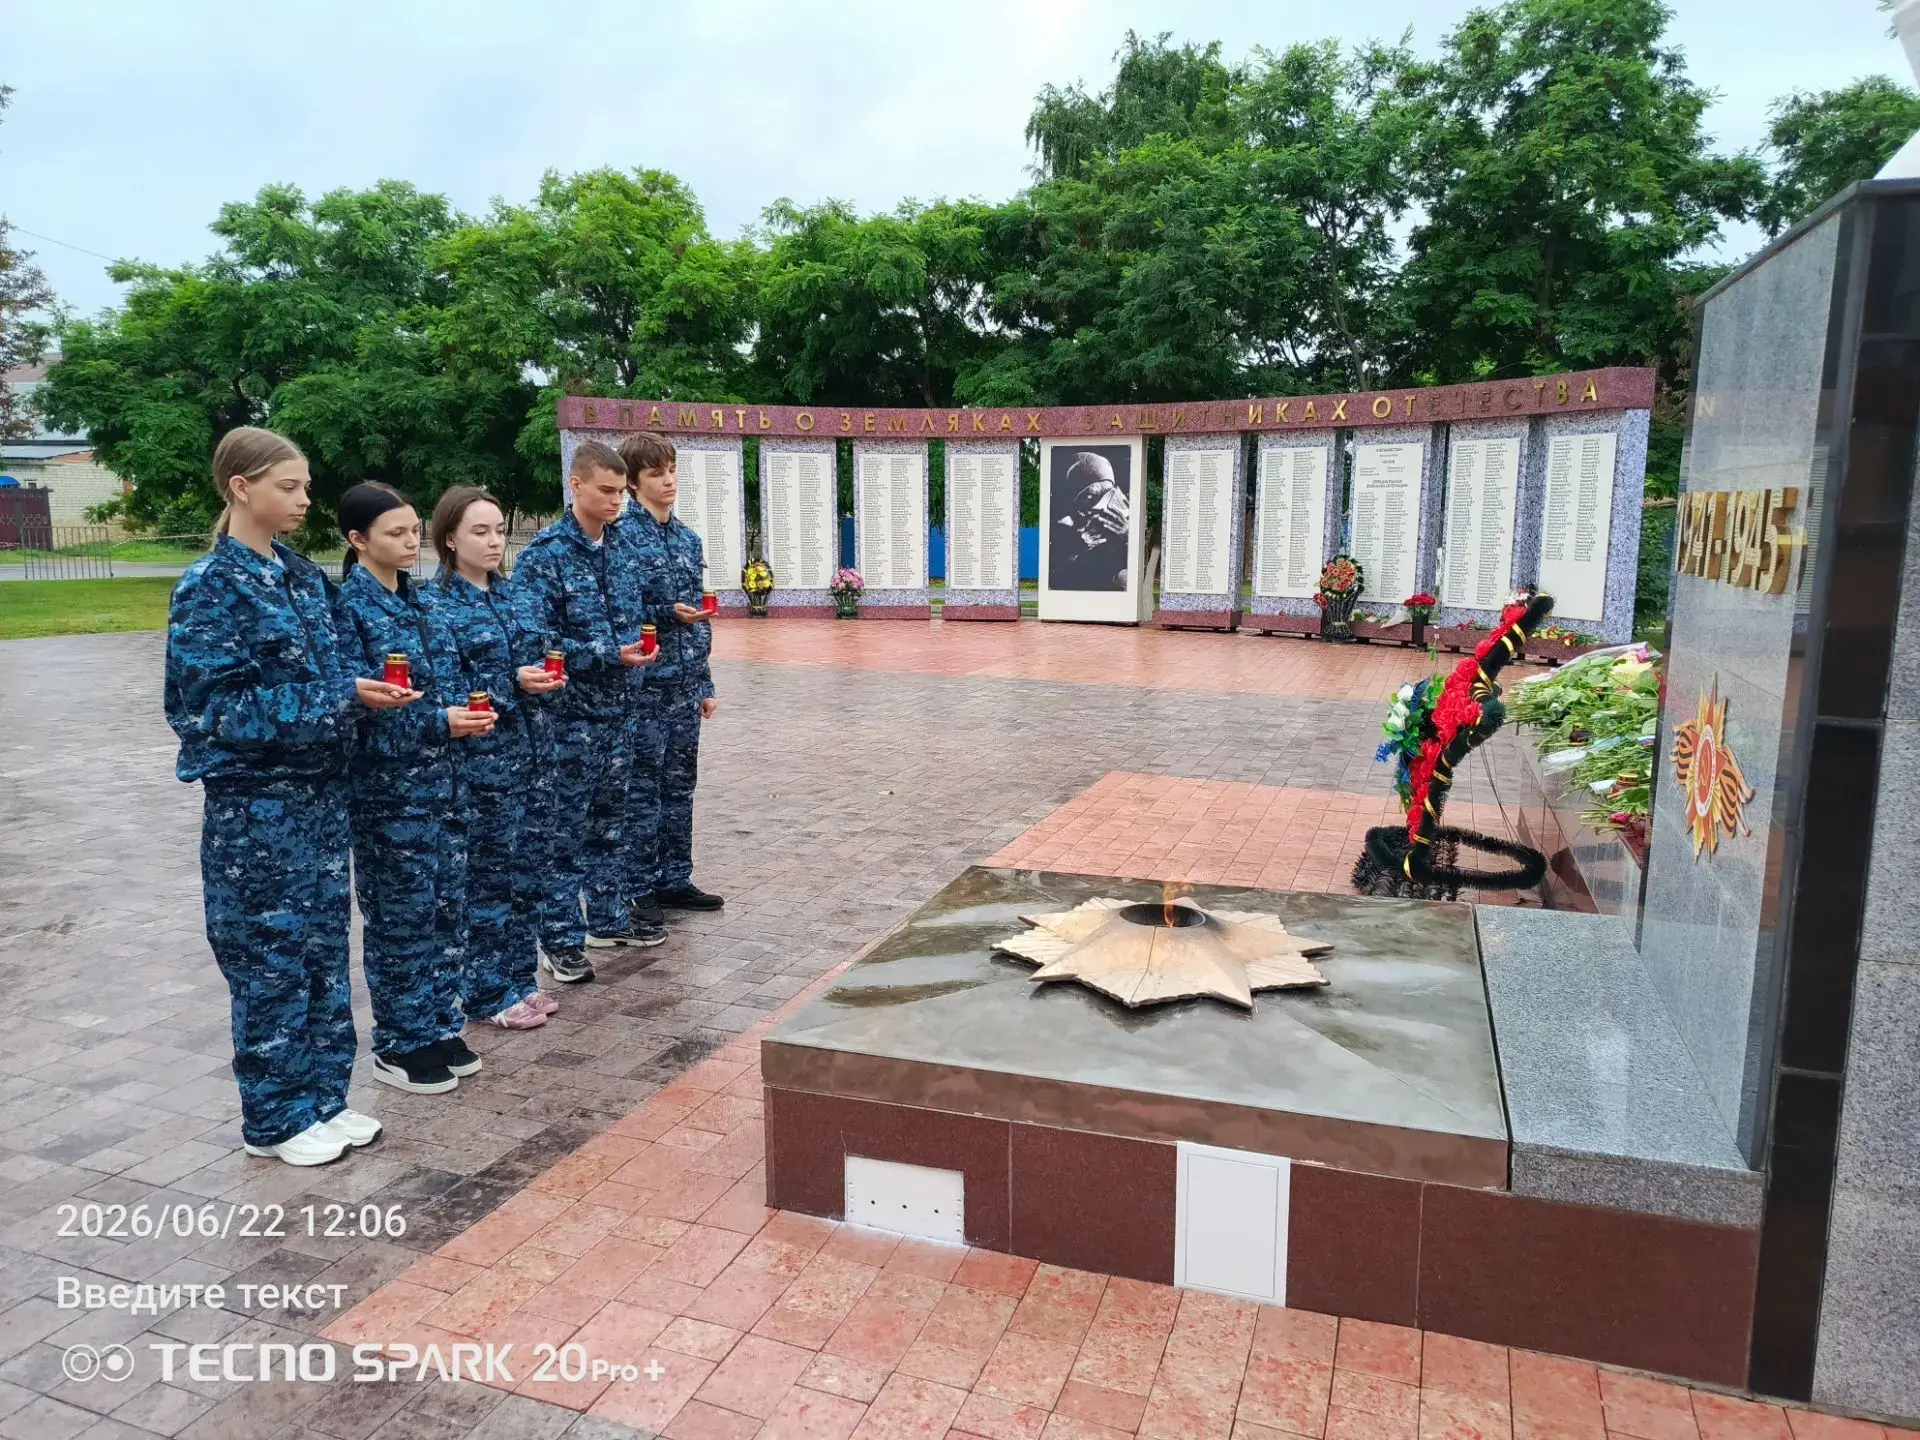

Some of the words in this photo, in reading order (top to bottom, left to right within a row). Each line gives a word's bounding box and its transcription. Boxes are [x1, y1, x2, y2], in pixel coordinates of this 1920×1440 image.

[584, 403, 598, 424] В
[618, 405, 773, 431] ПАМЯТЬ
[795, 410, 815, 432] О
[839, 411, 1042, 433] ЗЕМЛЯКАХ
[1083, 399, 1348, 432] ЗАЩИТНИКАХ
[1372, 376, 1598, 418] ОТЕЧЕСТВА
